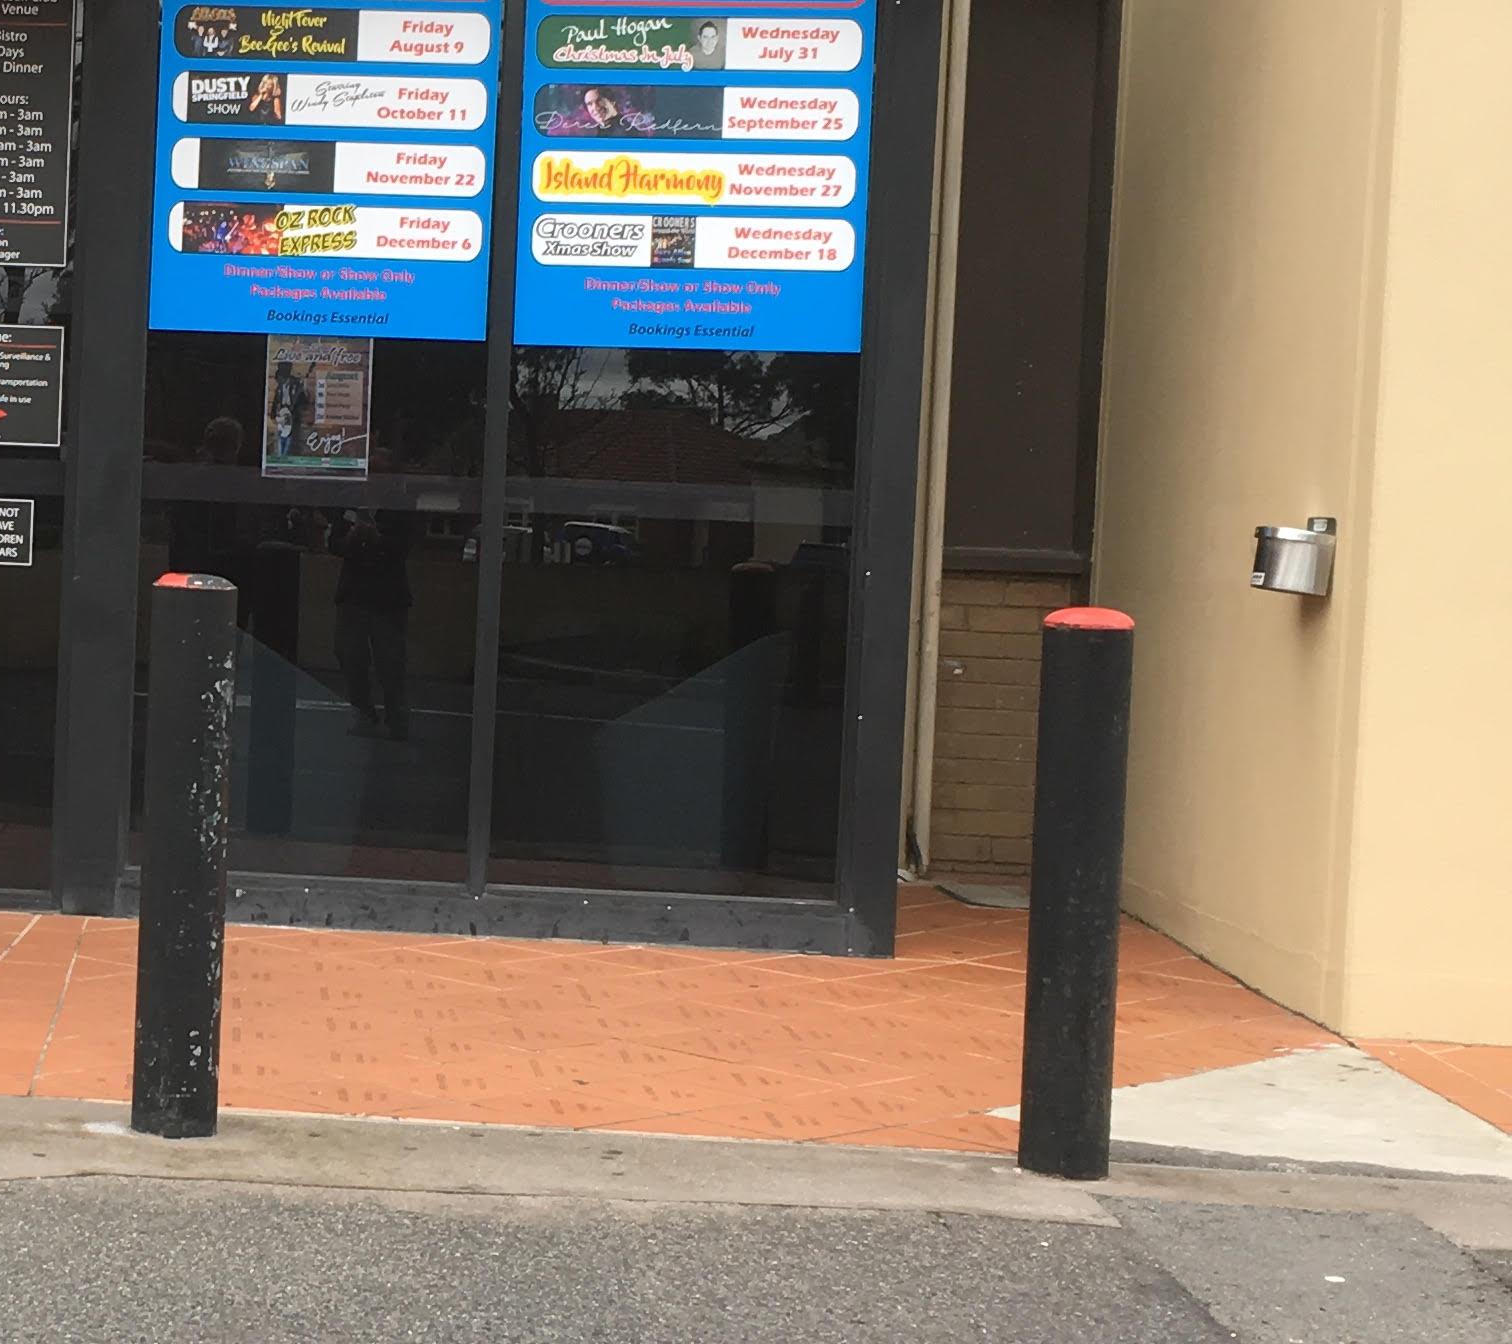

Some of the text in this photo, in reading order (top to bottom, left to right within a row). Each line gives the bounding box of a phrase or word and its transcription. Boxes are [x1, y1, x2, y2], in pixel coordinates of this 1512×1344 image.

[2, 3, 39, 15] Venue
[402, 19, 454, 37] Friday
[561, 16, 673, 47] Paul Hogan
[742, 25, 841, 44] Wednesday
[389, 38, 465, 57] August 9
[758, 46, 818, 63] July 31
[3, 61, 44, 74] Dinner
[191, 76, 251, 94] DUSTY
[397, 87, 450, 105] Friday
[740, 95, 838, 114] Wednesday
[17, 109, 44, 121] 3am
[207, 103, 241, 115] SHOW
[376, 106, 467, 122] October 11
[16, 124, 43, 136] 3am
[727, 117, 844, 134] September 25
[26, 140, 52, 153] 3am
[18, 156, 45, 168] 3am
[395, 152, 448, 169] Friday
[9, 171, 35, 183] 3am
[366, 171, 476, 187] November 22
[543, 158, 724, 200] Island Harmony
[738, 164, 837, 181] Wednesday
[16, 187, 43, 199] 3am
[729, 182, 843, 198] November 27
[3, 202, 54, 217] 11.30pm
[275, 204, 356, 231] OZ ROCK
[399, 216, 451, 234] Friday
[536, 217, 645, 241] Crooners
[279, 230, 357, 255] EXPRESS
[376, 234, 472, 251] December 6
[734, 227, 833, 245] Wednesday
[542, 241, 589, 257] Xmas
[590, 242, 638, 258] Show
[727, 246, 838, 262] December 18
[267, 309, 390, 326] Bookings Essential
[628, 322, 755, 339] Bookings Essential
[0, 352, 44, 362] Surveillance
[44, 353, 51, 362] &
